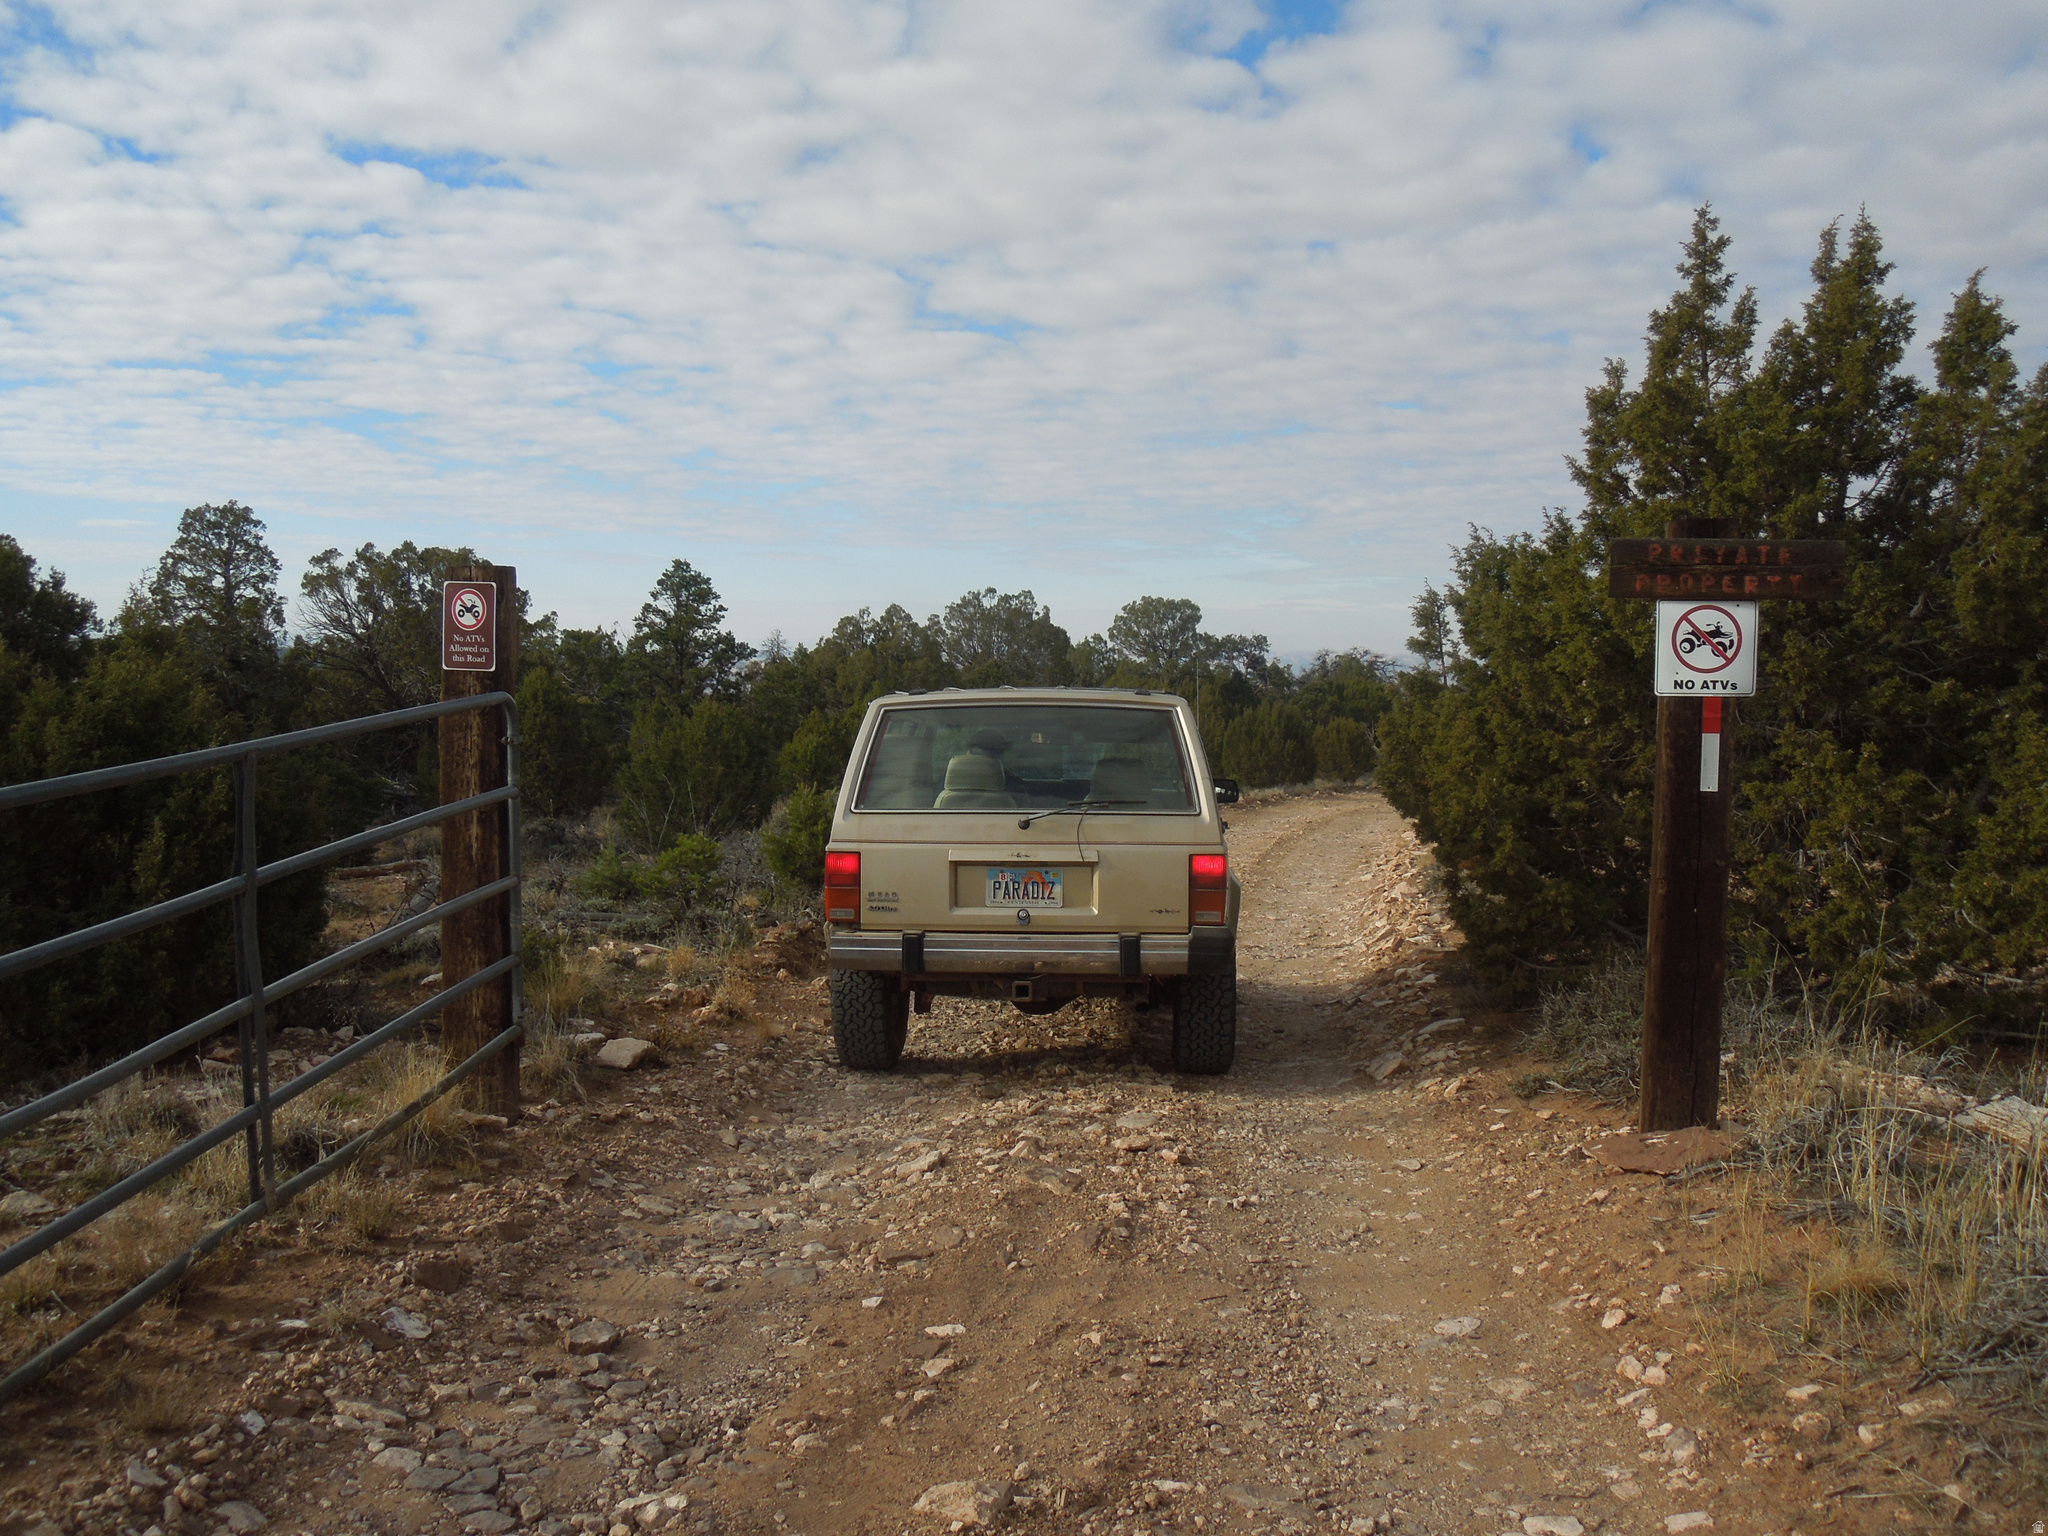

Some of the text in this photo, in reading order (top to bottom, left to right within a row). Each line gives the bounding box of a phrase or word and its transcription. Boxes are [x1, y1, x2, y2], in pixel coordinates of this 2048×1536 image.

[1636, 574, 1803, 594] PROPERTY
[453, 634, 485, 642] No ATVs
[449, 644, 478, 652] Allowed
[467, 654, 486, 662] Road
[1673, 680, 1738, 690] NO ATVs
[993, 881, 1055, 900] PARADIZ
